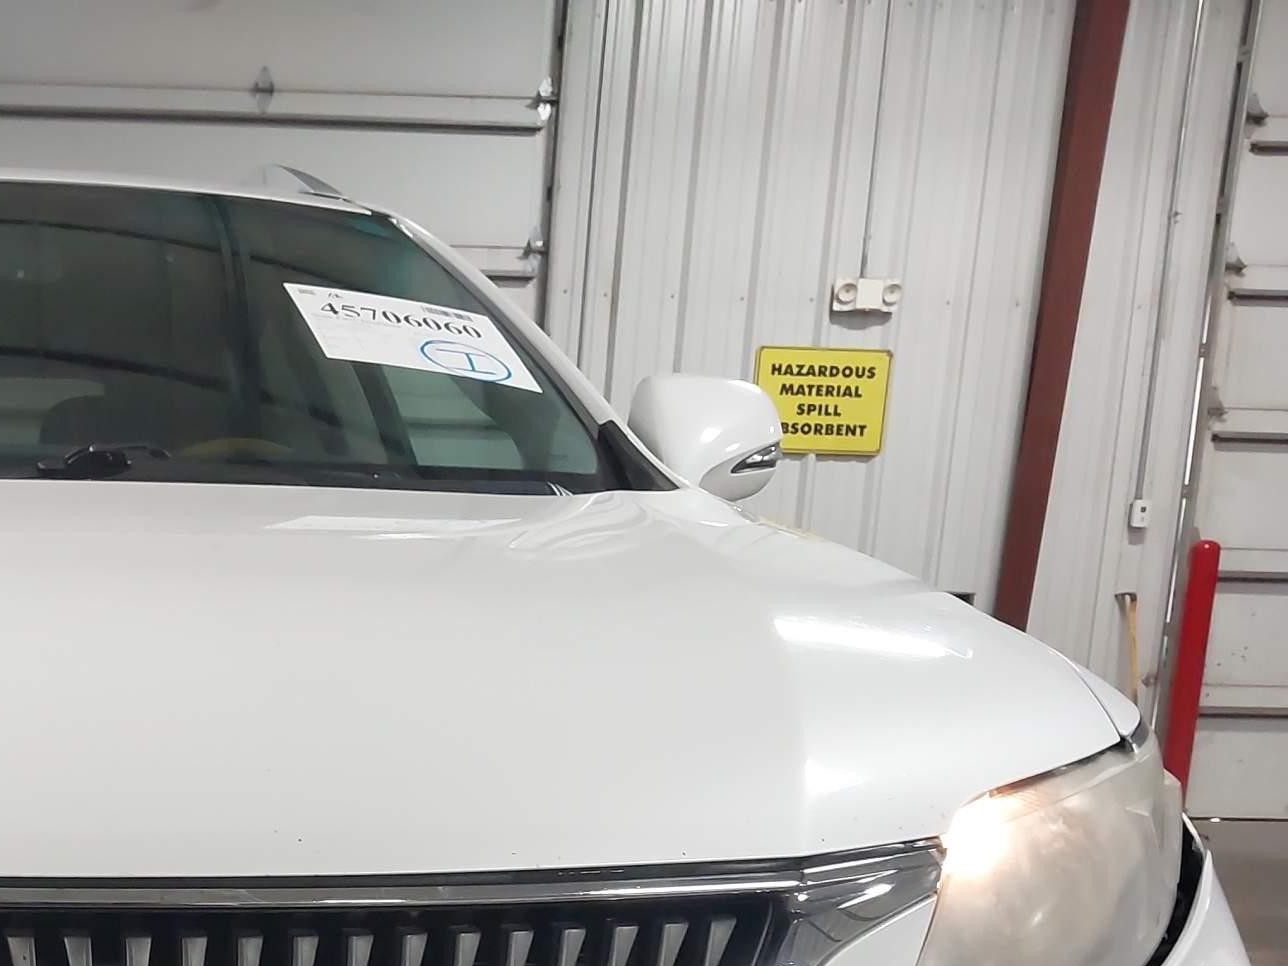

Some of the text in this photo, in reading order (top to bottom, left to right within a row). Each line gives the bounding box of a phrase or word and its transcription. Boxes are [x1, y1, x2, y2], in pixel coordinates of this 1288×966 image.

[321, 302, 482, 339] 45706060
[771, 363, 876, 379] HAZARDOUS
[779, 383, 862, 398] MATERIAL
[796, 403, 842, 417] SPILL
[780, 422, 867, 437] BSORBENT
